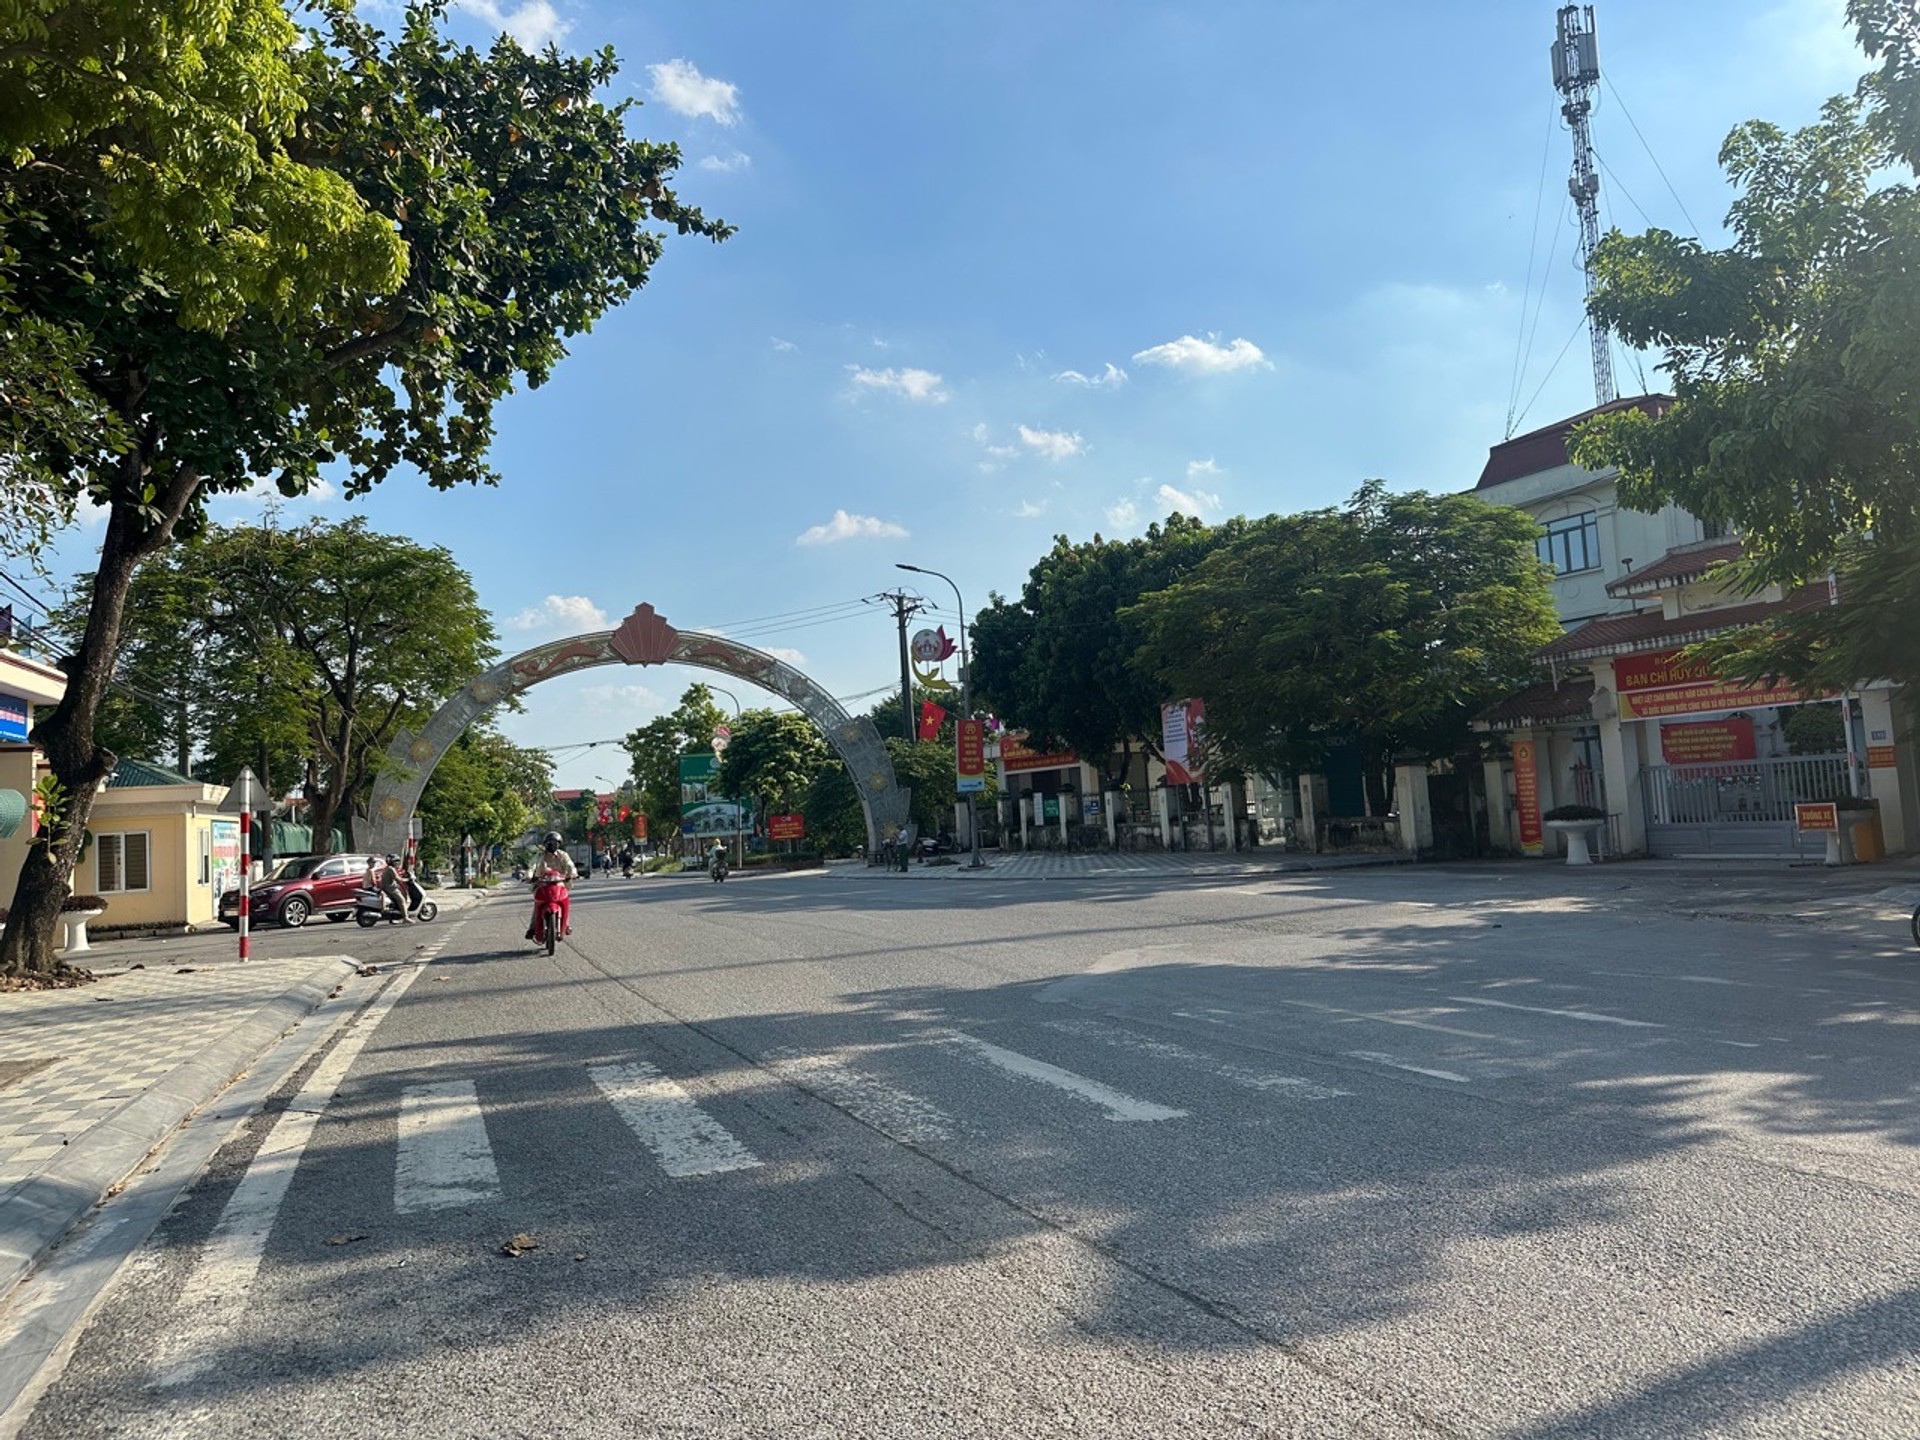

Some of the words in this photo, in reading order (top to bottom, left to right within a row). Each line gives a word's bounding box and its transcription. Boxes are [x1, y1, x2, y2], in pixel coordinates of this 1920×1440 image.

[1625, 674, 1648, 687] BAN
[1669, 667, 1692, 682] HUY
[1824, 810, 1832, 820] XE
